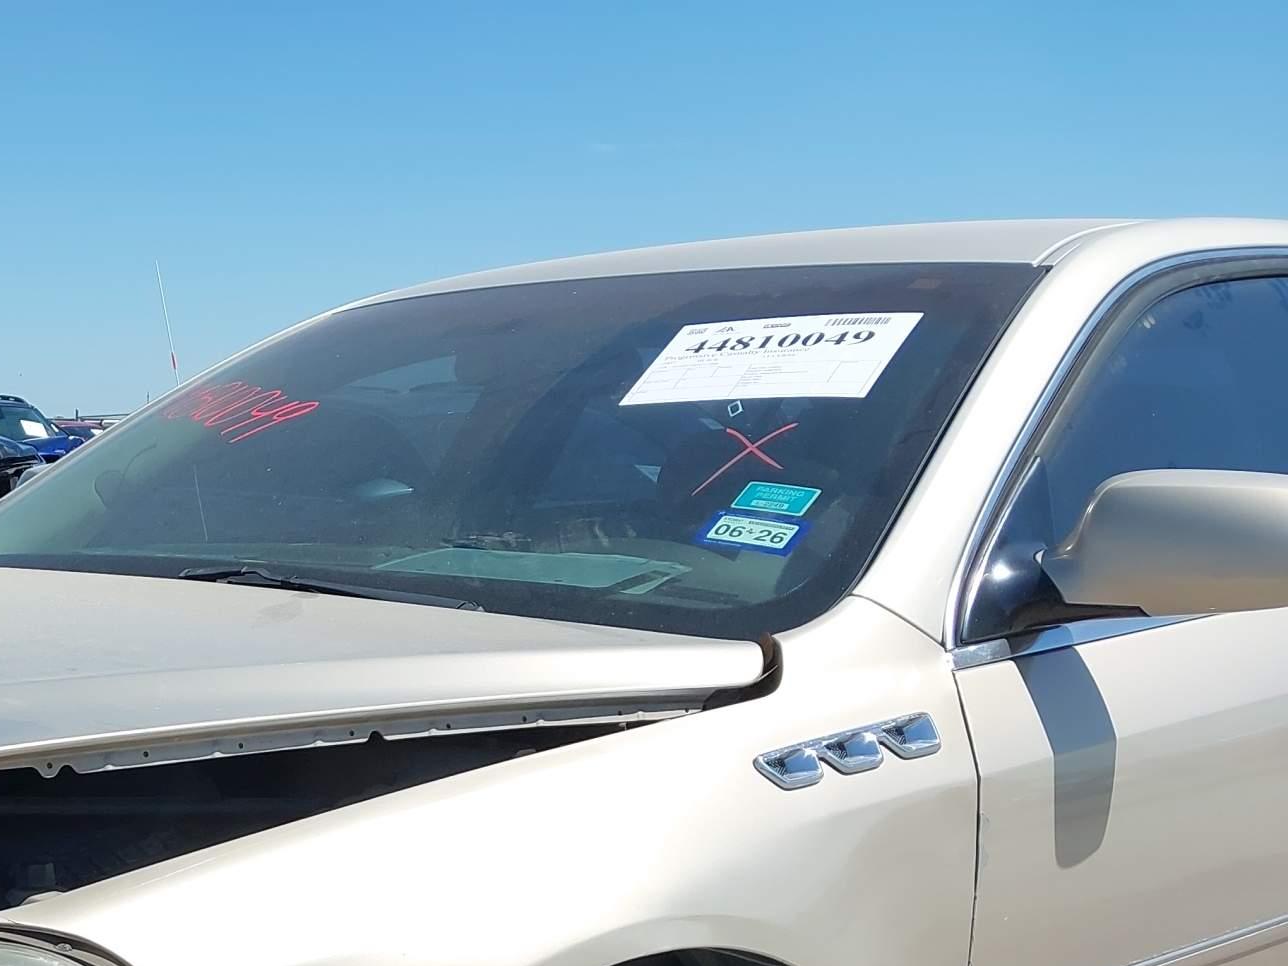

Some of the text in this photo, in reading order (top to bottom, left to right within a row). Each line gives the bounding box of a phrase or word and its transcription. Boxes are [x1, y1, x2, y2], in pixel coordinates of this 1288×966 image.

[685, 330, 876, 354] 44810049
[755, 492, 798, 502] PERMIT
[757, 486, 805, 497] PARKING
[714, 524, 746, 538] 06
[753, 529, 788, 544] 26
